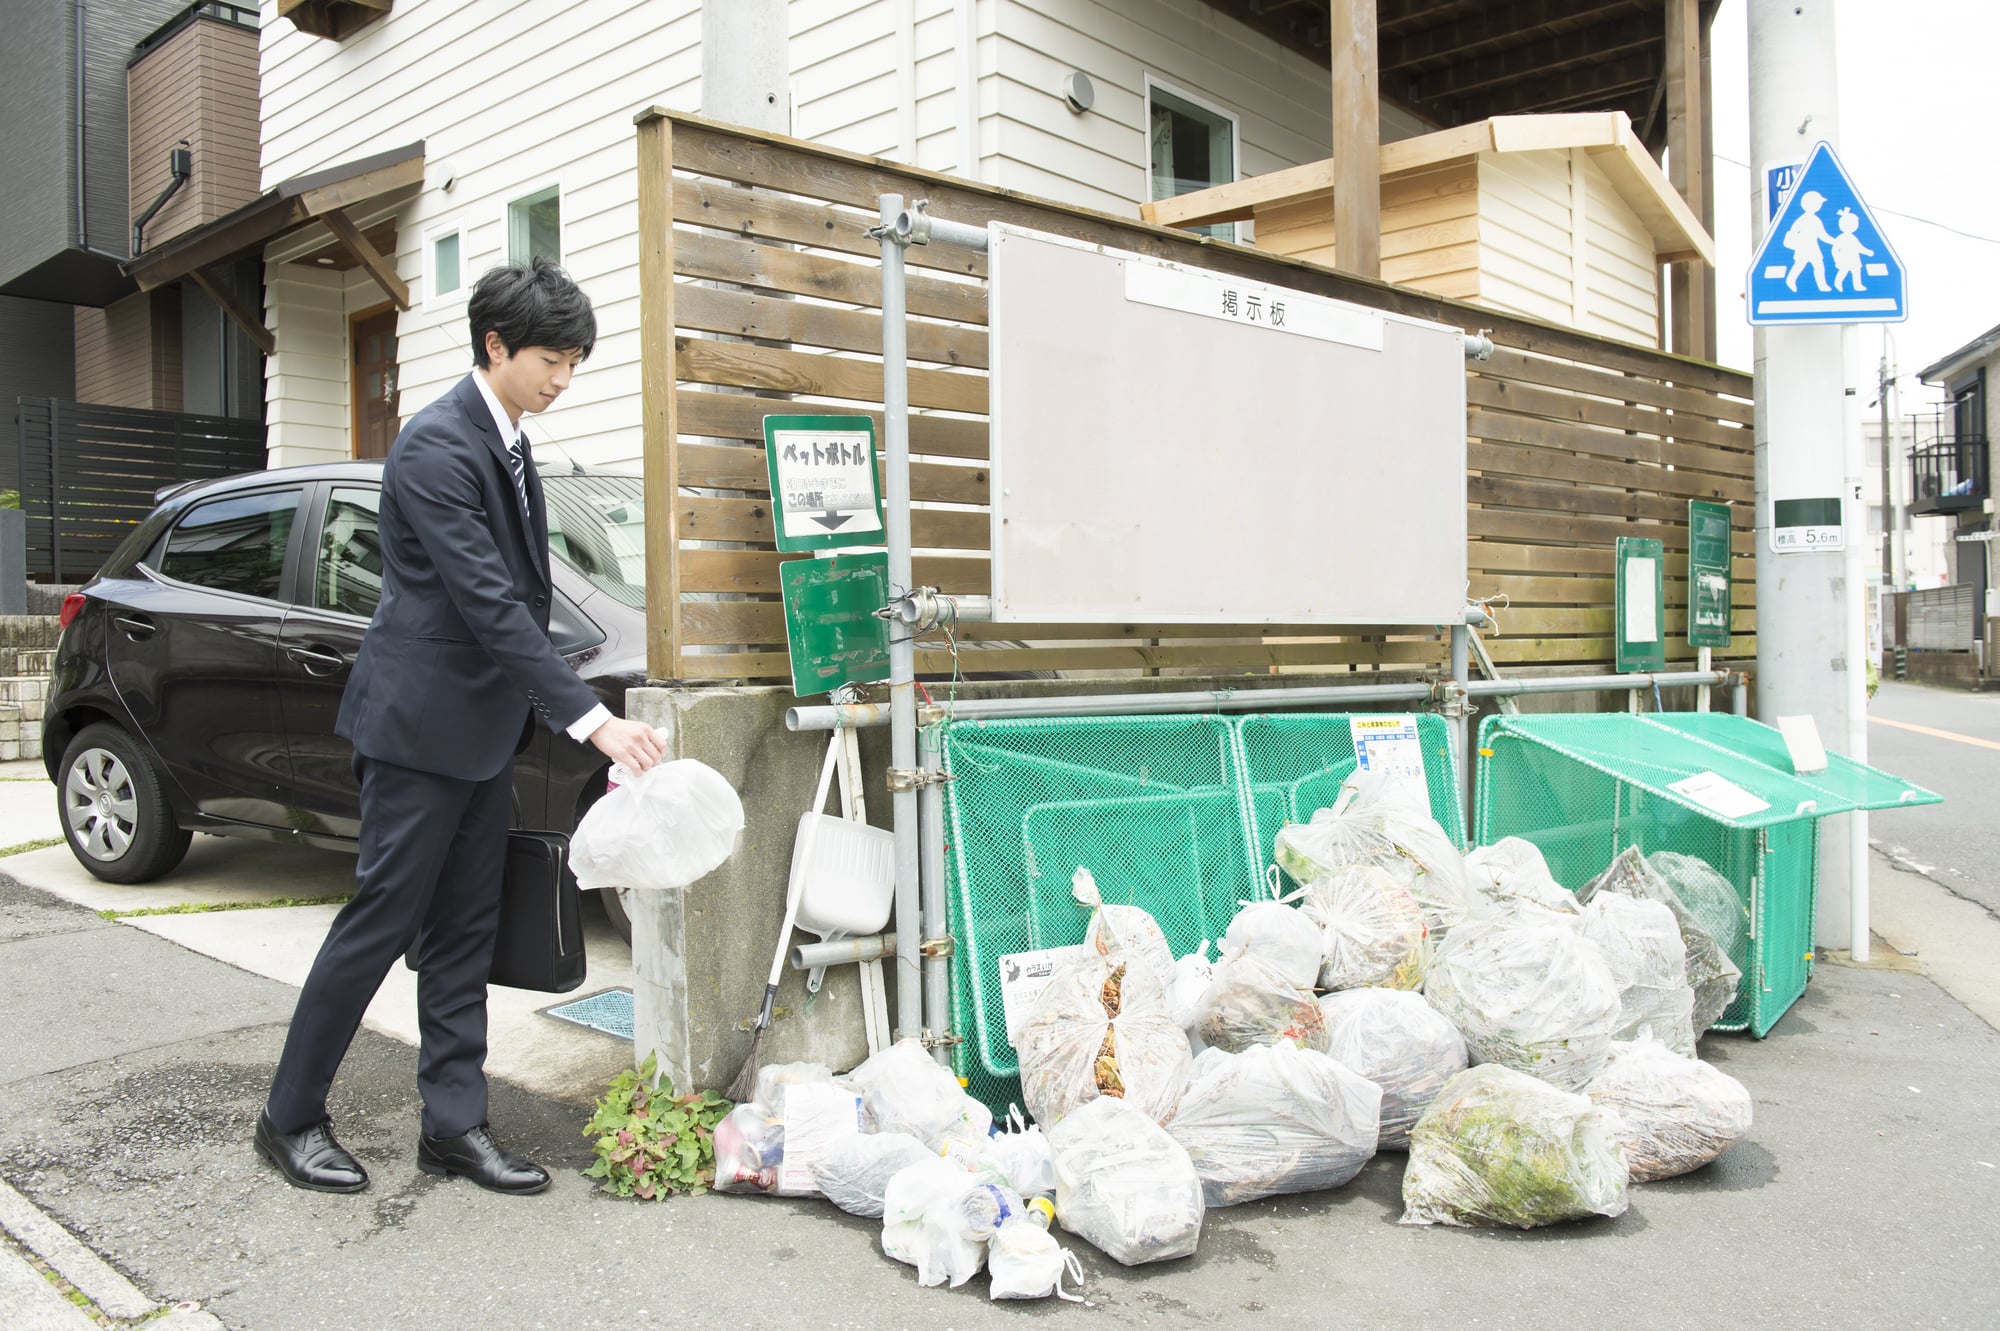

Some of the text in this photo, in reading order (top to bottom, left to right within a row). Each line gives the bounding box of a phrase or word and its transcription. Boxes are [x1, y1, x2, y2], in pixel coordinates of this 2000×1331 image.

[1222, 289, 1286, 326] 掲示板
[783, 442, 866, 466] ペットボトル
[1777, 529, 1838, 545] 標高 5.6m
